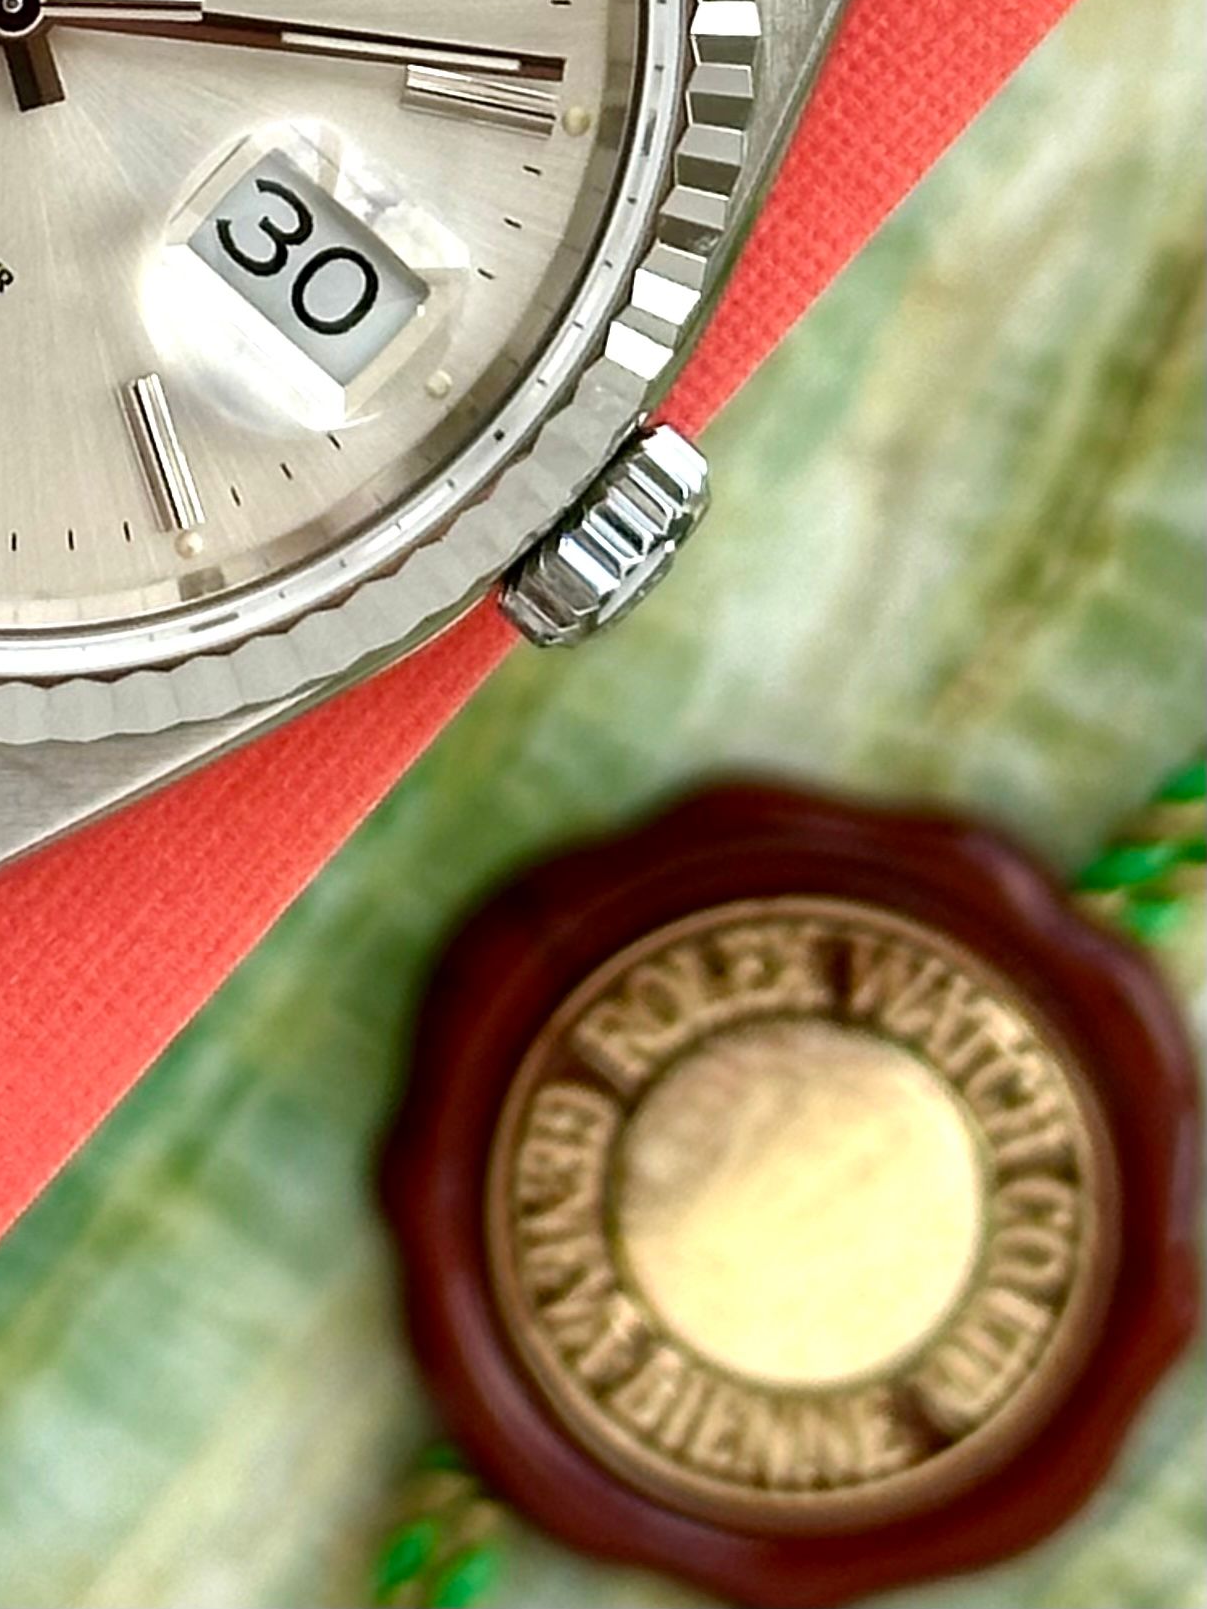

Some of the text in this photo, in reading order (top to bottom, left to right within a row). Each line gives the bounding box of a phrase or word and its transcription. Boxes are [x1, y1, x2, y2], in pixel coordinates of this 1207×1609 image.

[215, 178, 379, 335] 30
[574, 925, 831, 1089] ROLEX
[847, 933, 1076, 1182] WATCH
[611, 1344, 916, 1492] BIENNE
